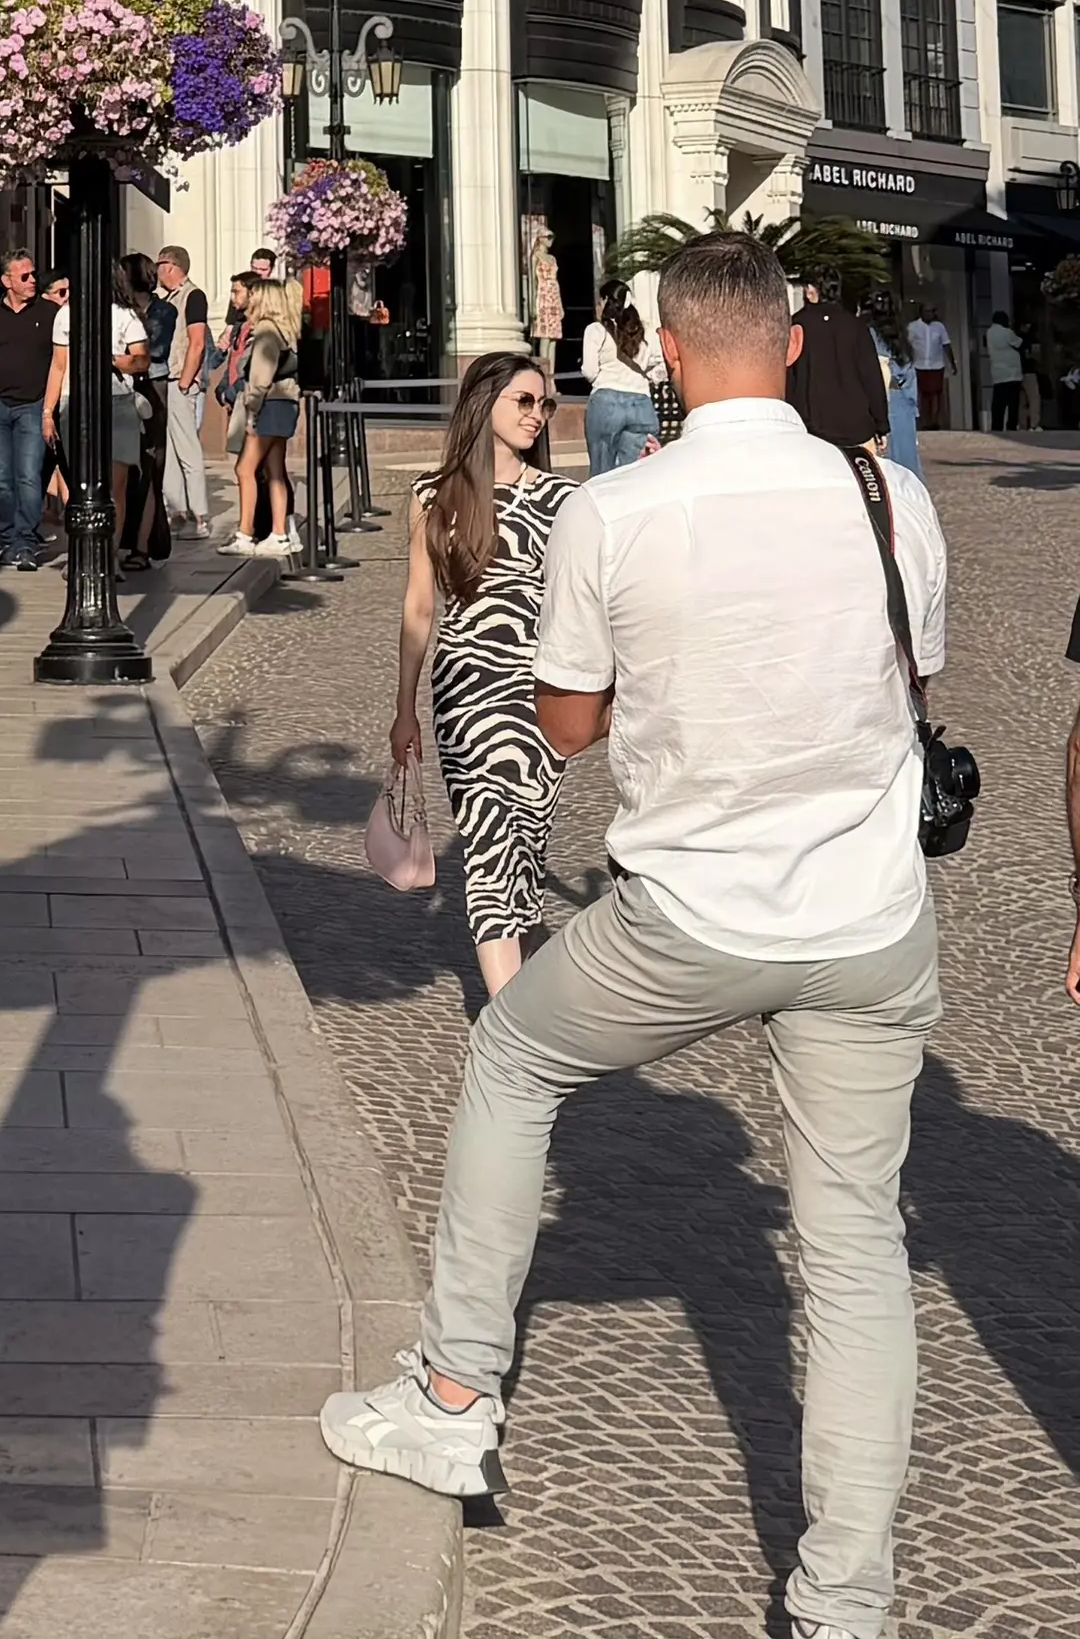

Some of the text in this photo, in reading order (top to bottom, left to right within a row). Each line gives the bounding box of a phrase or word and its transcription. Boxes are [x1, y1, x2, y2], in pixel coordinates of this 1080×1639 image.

[813, 164, 915, 193] ABEL RICHARD
[879, 222, 919, 238] RICHARD
[955, 232, 1014, 249] ABEL RICHARD
[854, 457, 881, 502] Canon
